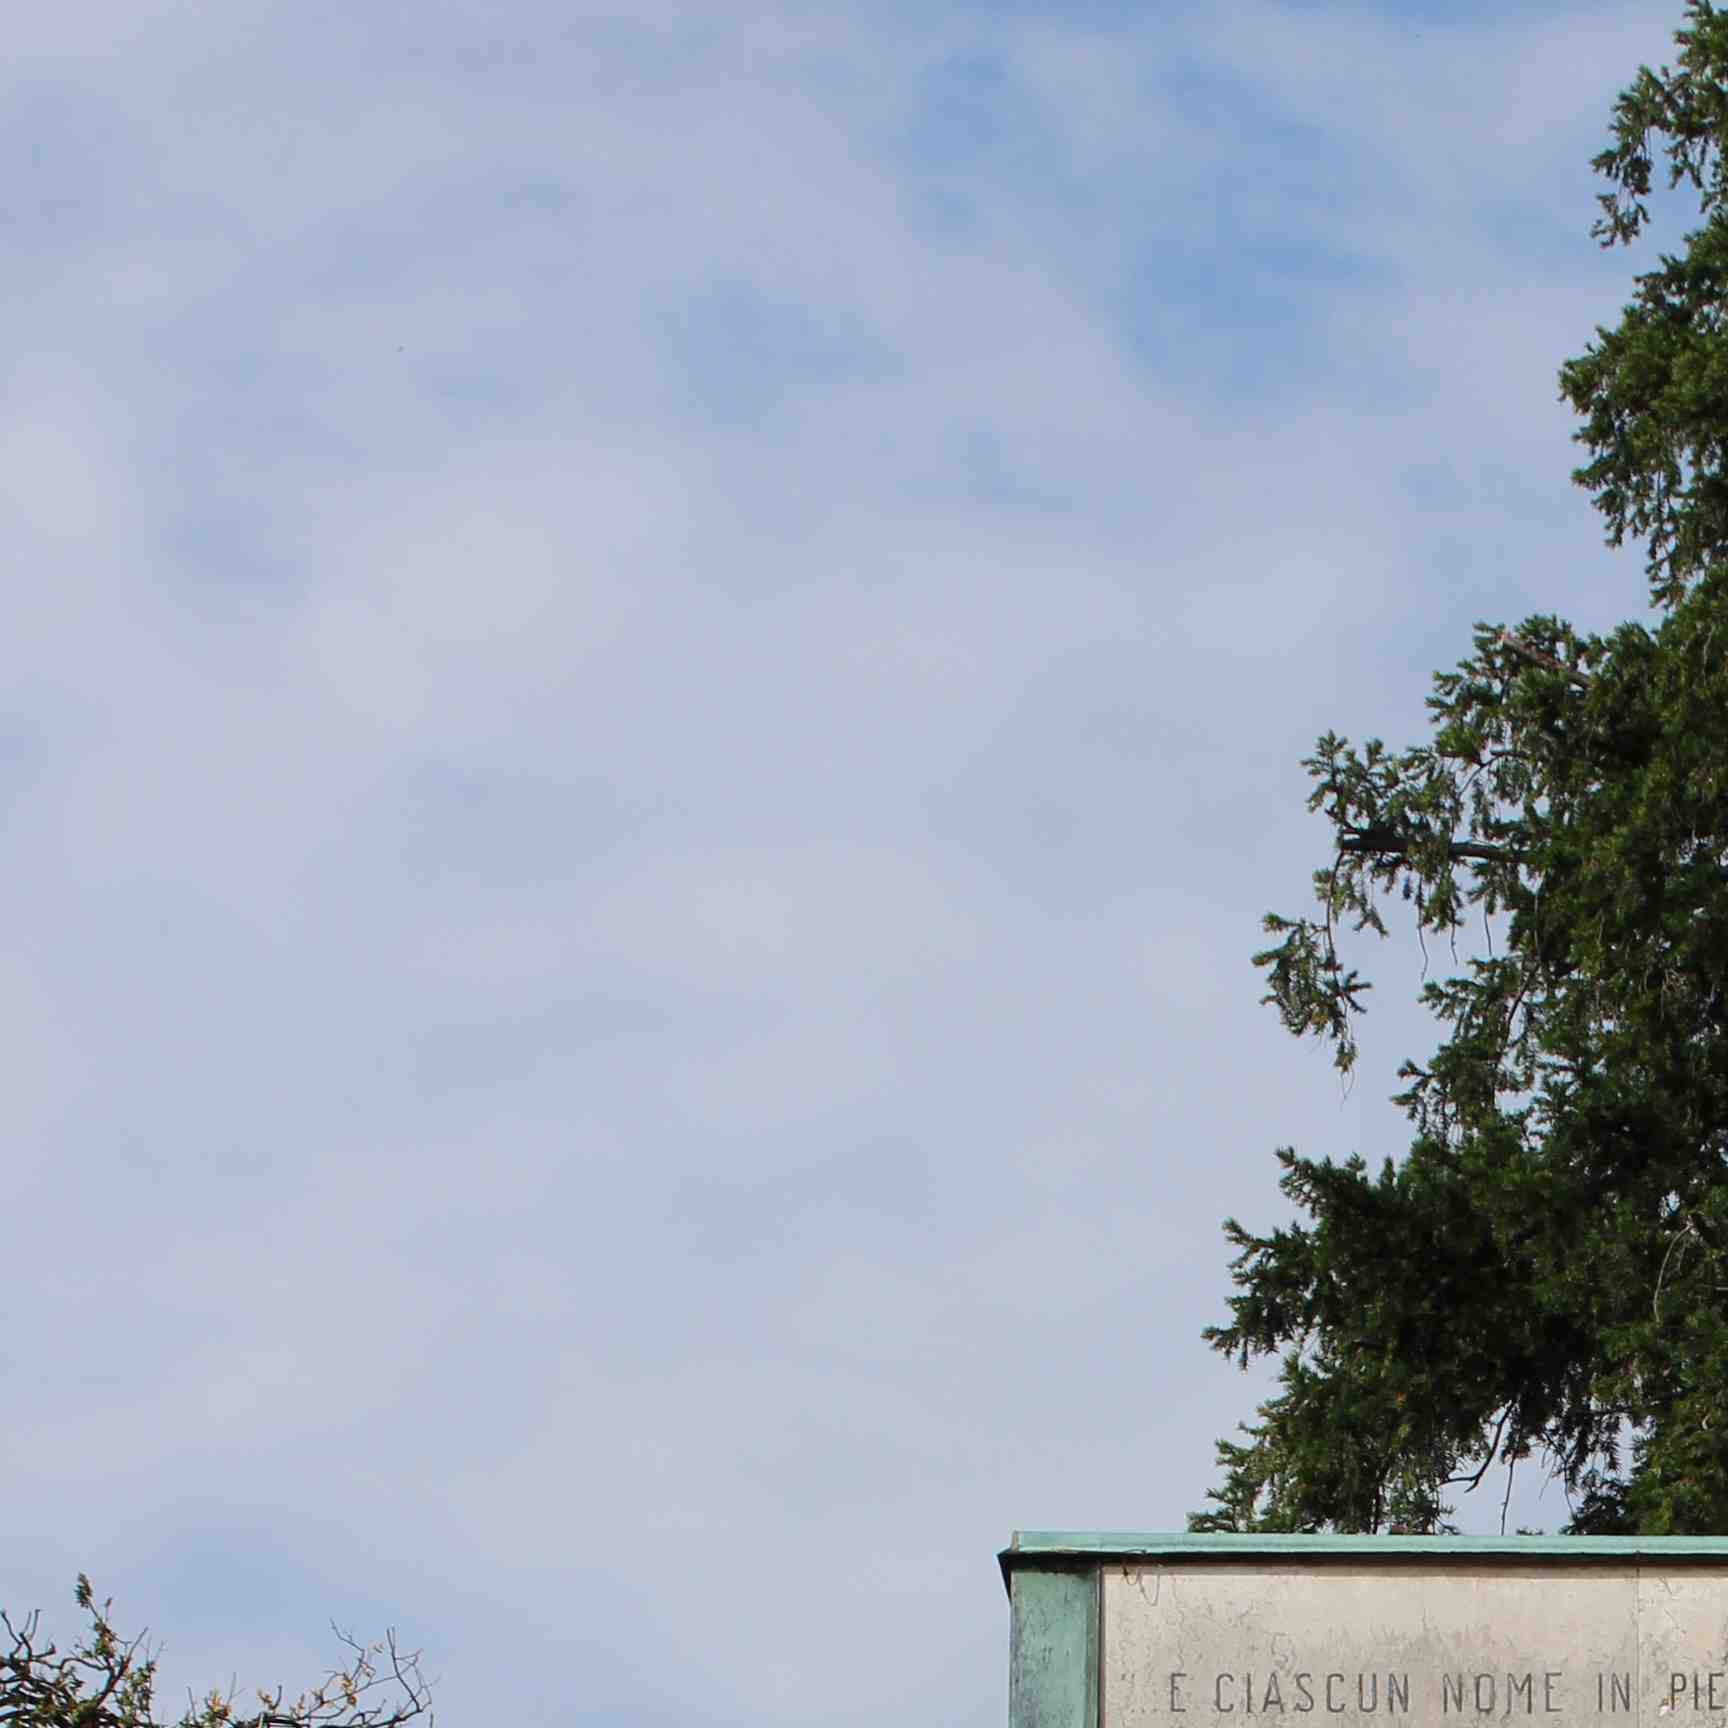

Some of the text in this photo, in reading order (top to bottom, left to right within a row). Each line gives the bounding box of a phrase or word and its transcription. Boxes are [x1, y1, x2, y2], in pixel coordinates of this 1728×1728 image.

[1169, 1672, 1188, 1713] E
[1215, 1672, 1410, 1714] CIASCUN
[1442, 1672, 1562, 1715] NOME
[1597, 1672, 1632, 1714] IN
